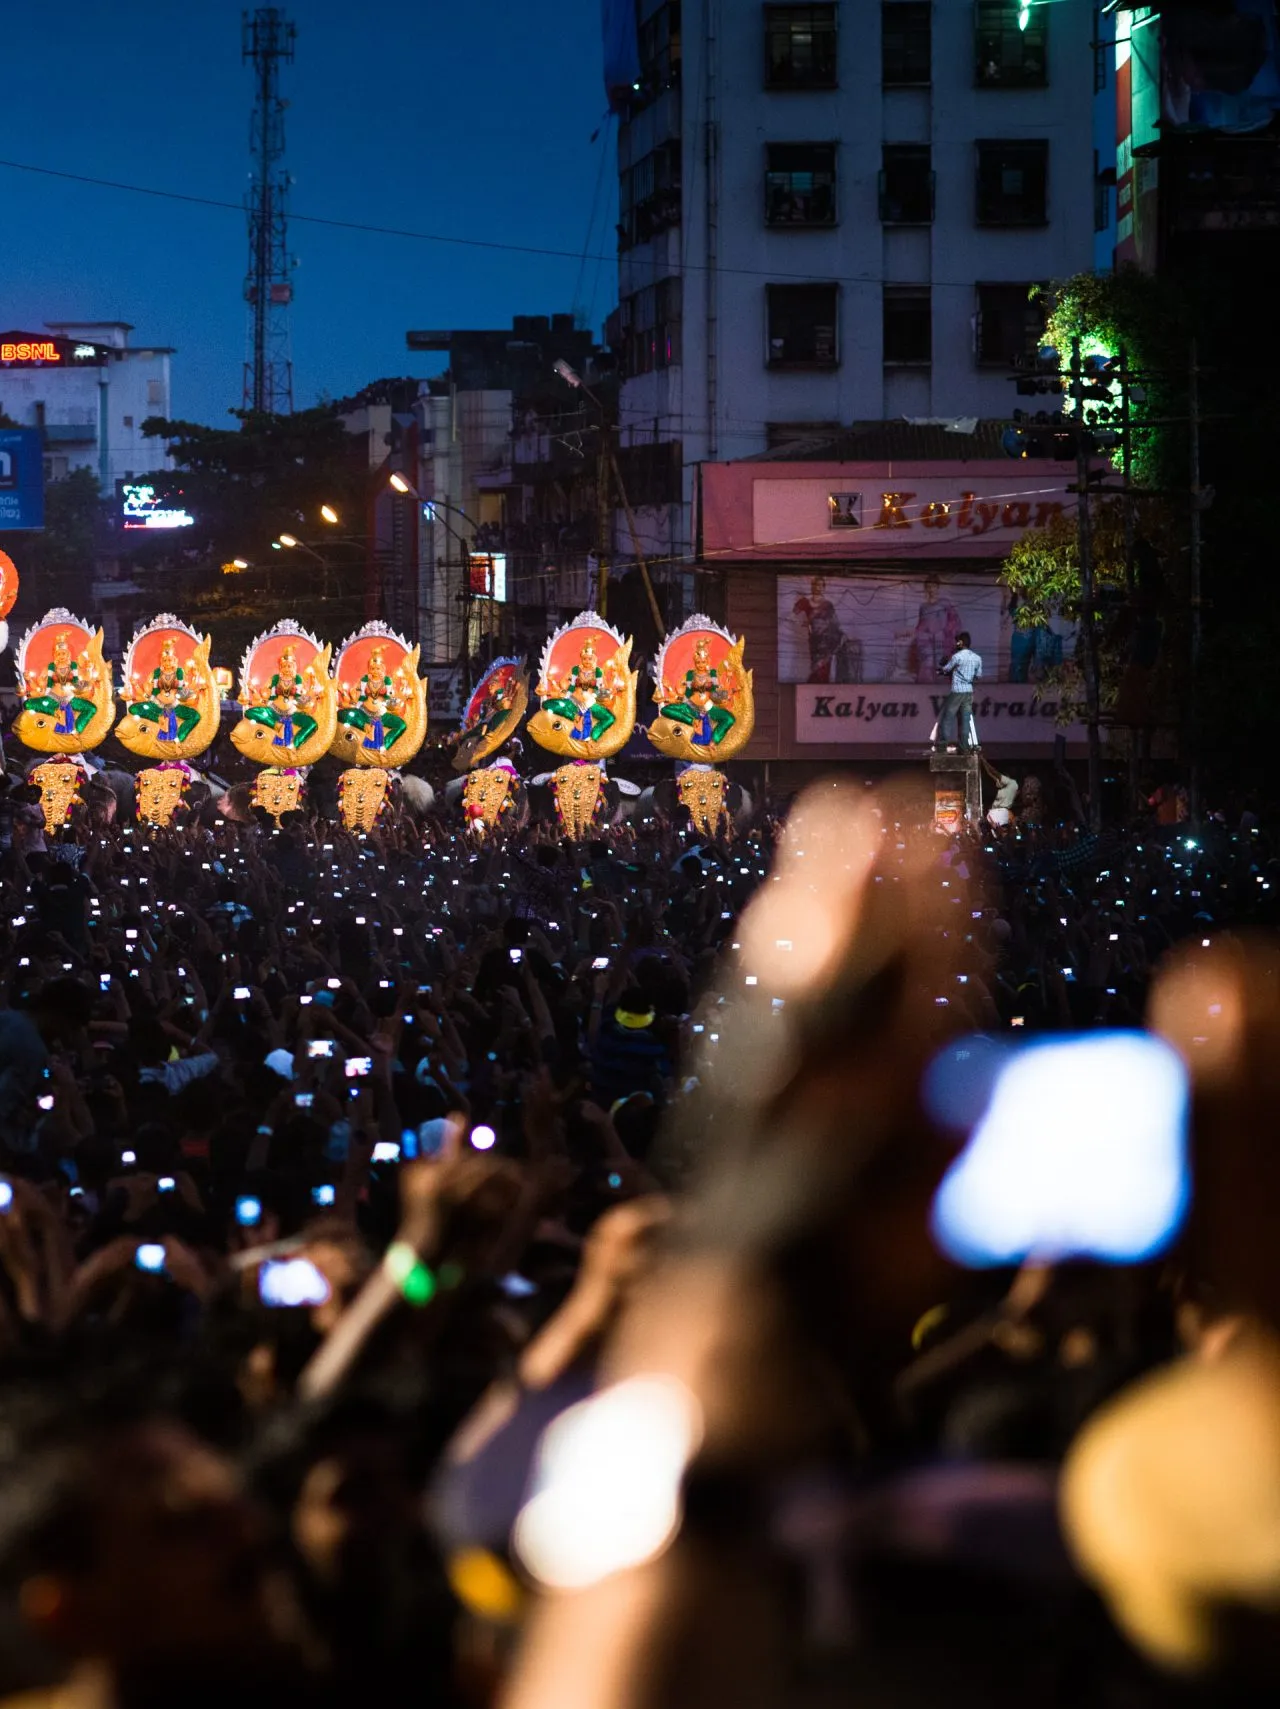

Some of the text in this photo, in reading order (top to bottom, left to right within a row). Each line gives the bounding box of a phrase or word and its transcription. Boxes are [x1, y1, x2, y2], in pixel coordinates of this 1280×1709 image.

[1, 343, 60, 360] BSNL
[873, 492, 1064, 534] Kalyan
[811, 697, 918, 722] Kalyan
